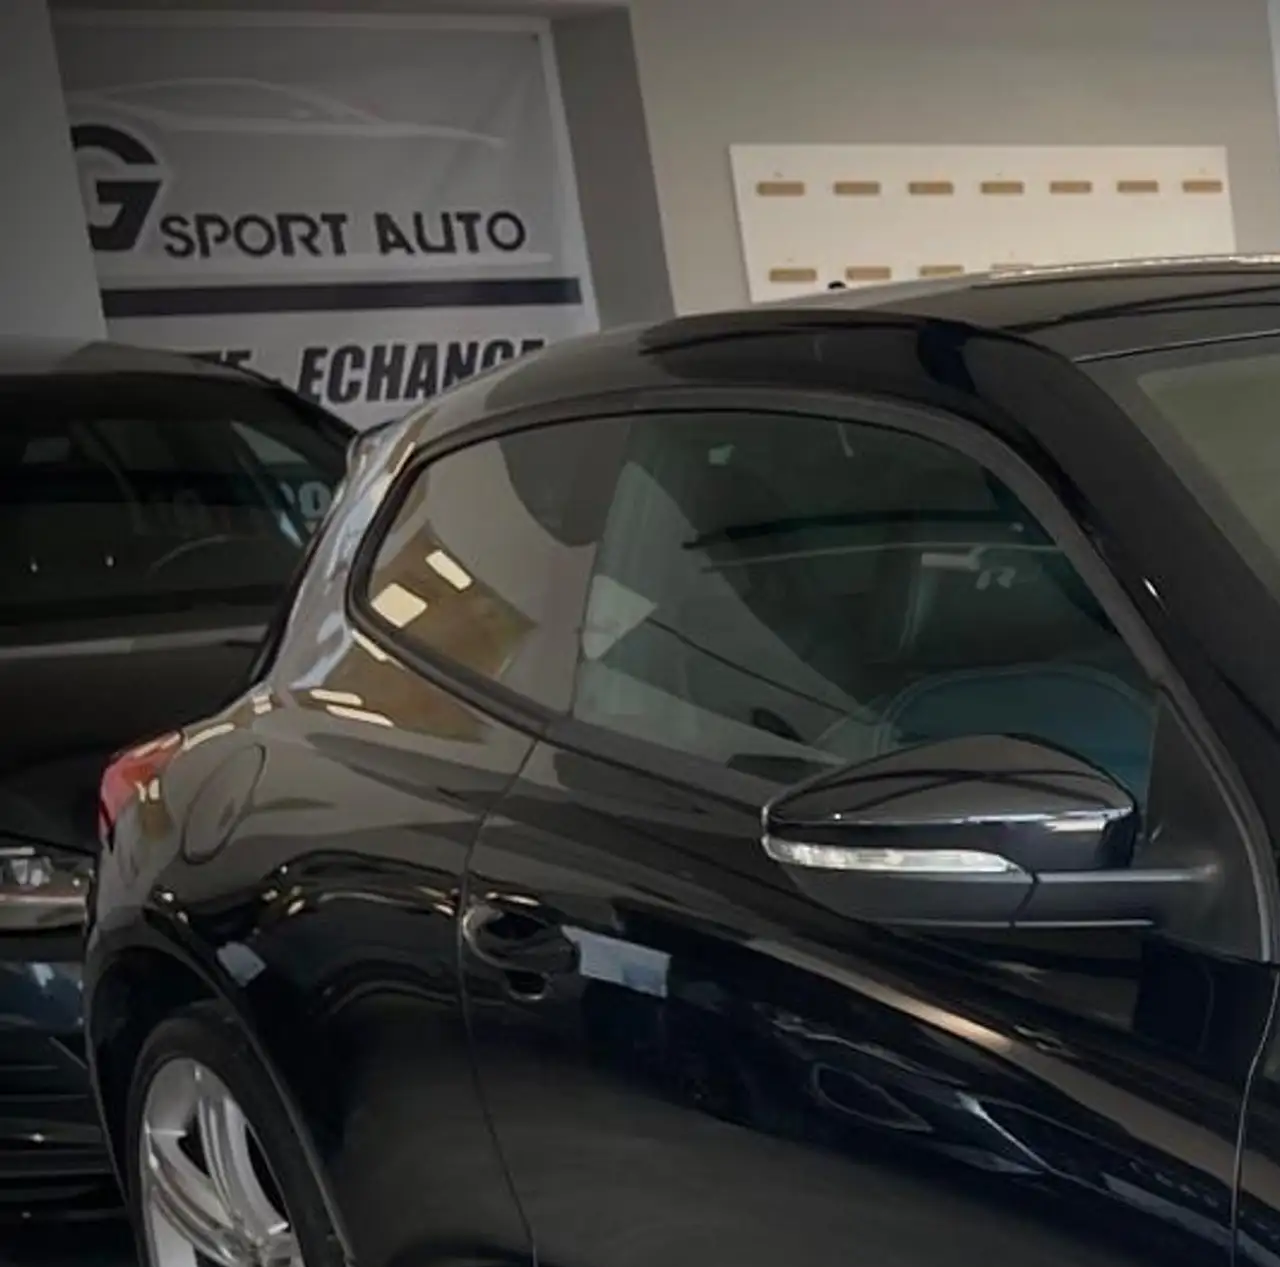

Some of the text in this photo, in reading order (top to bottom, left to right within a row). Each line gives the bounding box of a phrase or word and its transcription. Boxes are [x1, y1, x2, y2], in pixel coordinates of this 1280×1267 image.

[160, 213, 347, 258] SPORT
[374, 210, 526, 255] AUTO
[296, 339, 545, 405] ECHAN
